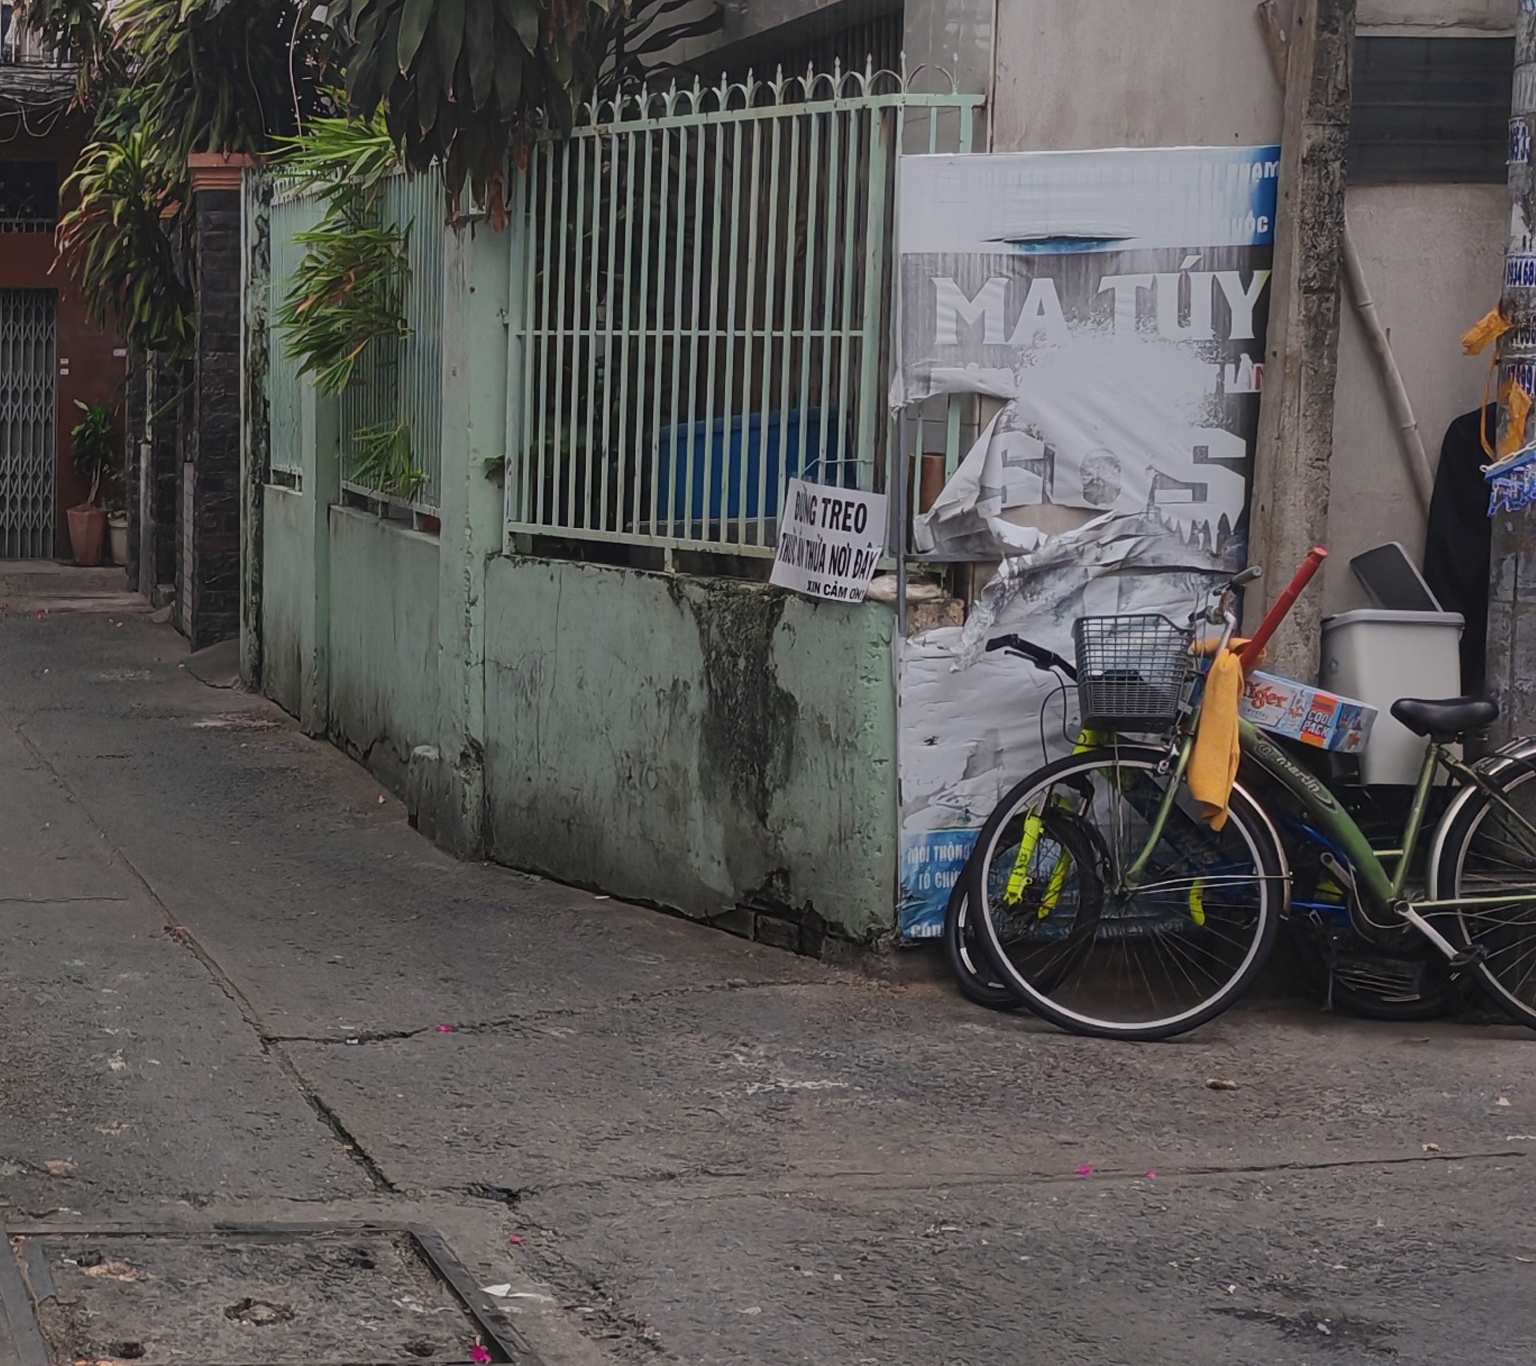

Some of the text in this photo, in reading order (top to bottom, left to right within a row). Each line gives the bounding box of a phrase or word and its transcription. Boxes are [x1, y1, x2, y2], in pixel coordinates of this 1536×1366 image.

[931, 254, 1272, 345] MA TÚY
[821, 497, 868, 534] TREO
[828, 542, 852, 578] NƠI
[806, 580, 822, 594] XIN
[1302, 720, 1330, 737] PACK
[1307, 709, 1334, 727] COOL
